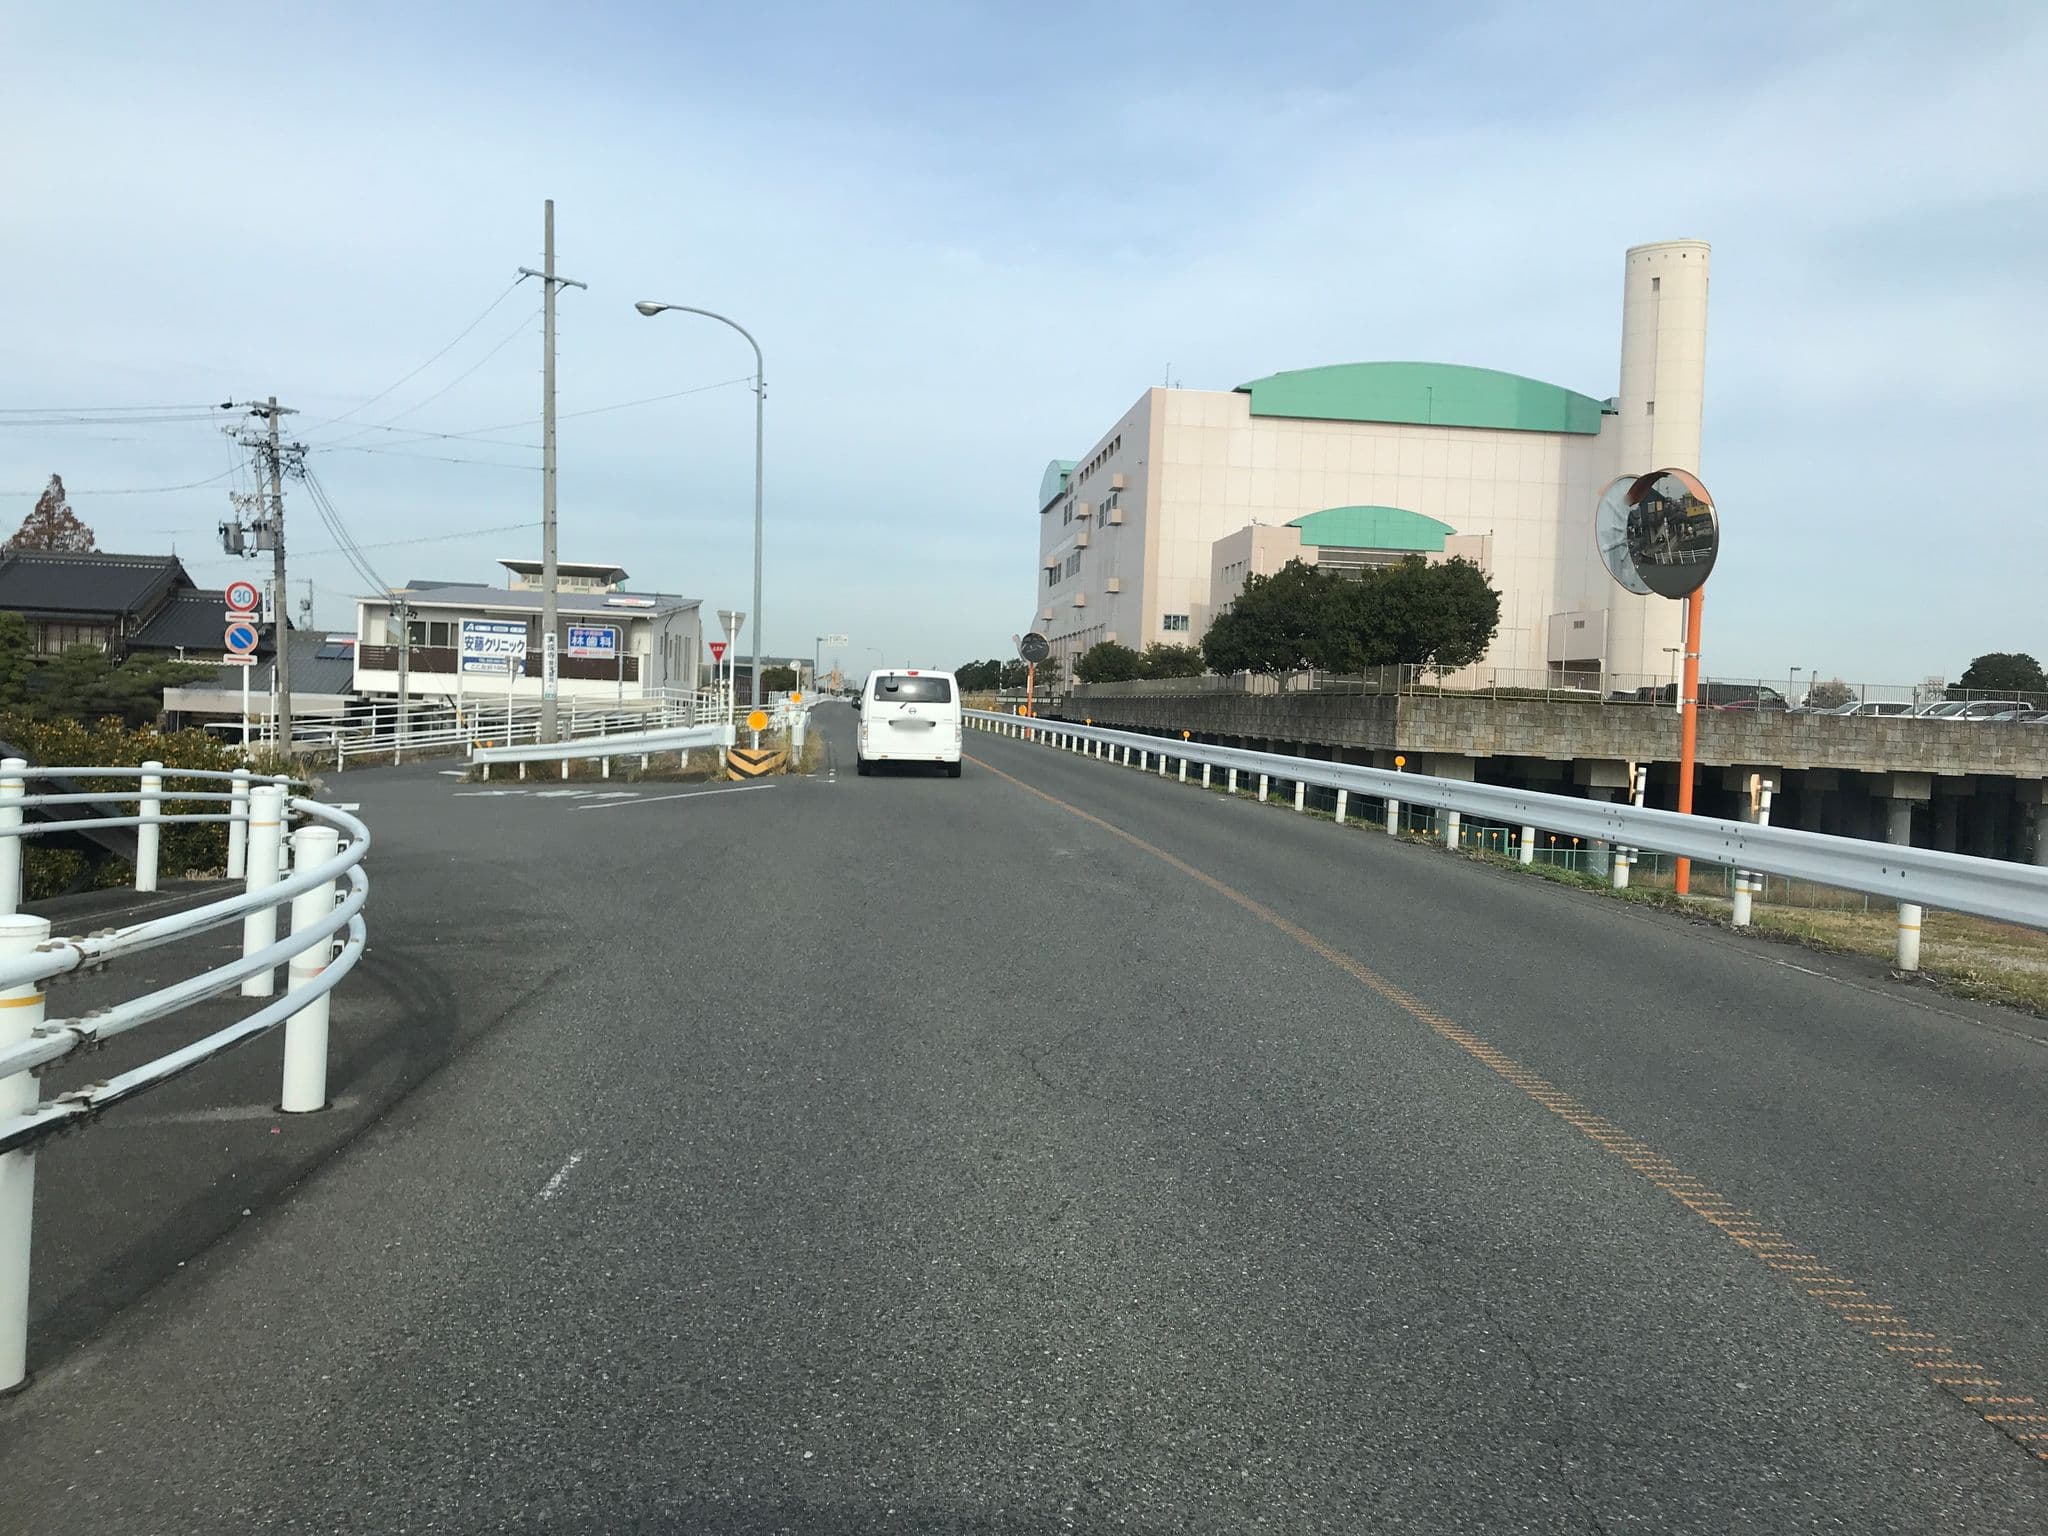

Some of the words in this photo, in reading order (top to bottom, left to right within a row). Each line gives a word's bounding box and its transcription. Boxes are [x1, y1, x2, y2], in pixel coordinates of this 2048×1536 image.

[233, 589, 251, 604] 30
[464, 635, 525, 654] 安藤クリニック
